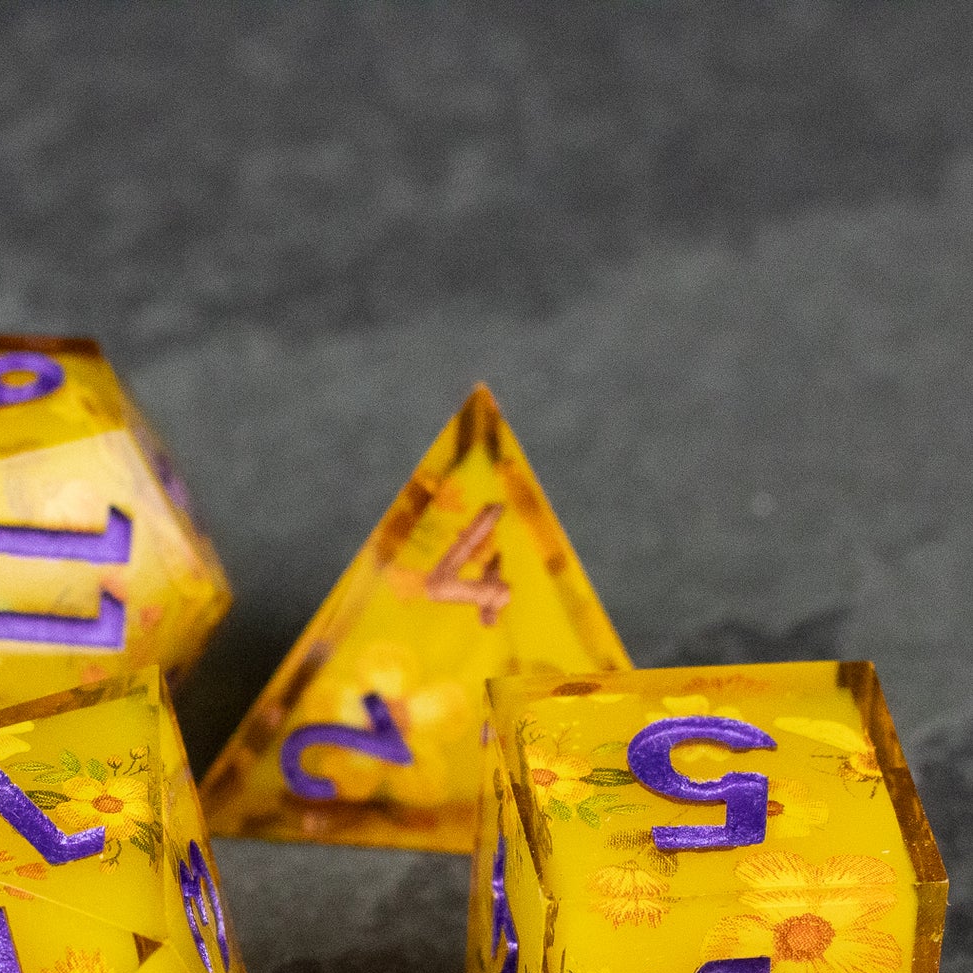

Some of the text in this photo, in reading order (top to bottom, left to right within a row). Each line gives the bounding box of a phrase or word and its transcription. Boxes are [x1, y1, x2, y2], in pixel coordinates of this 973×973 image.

[424, 503, 511, 627] 4
[280, 692, 414, 800] 2
[627, 715, 777, 852] 5
